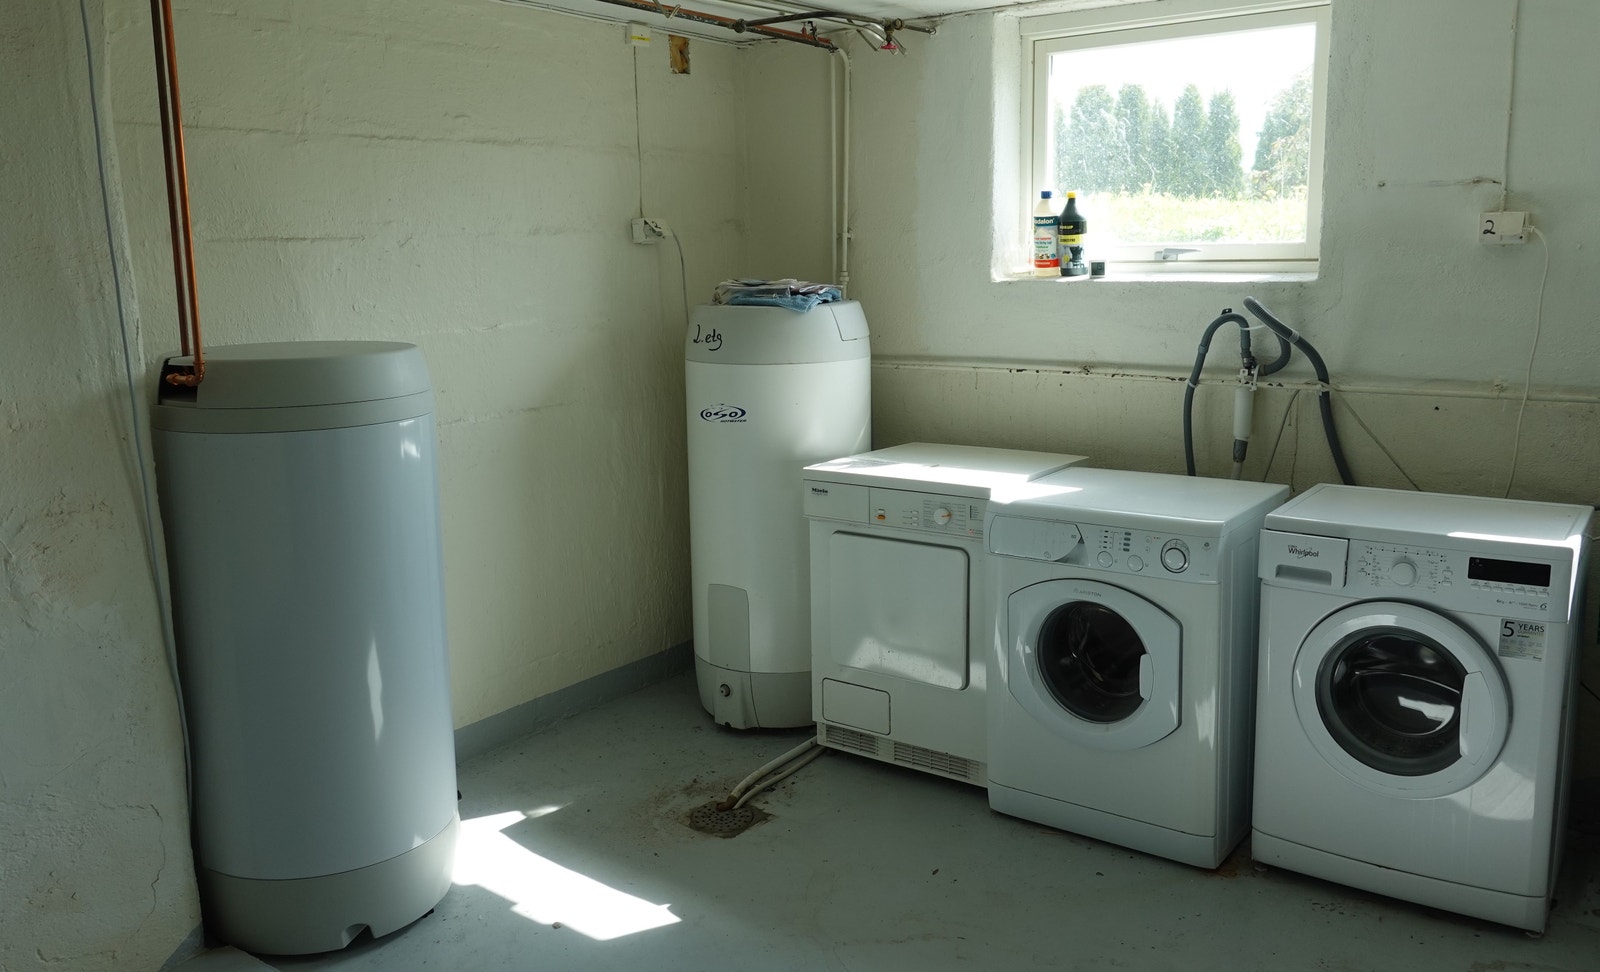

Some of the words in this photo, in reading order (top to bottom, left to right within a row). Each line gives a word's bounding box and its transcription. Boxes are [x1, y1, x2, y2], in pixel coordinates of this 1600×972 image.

[1483, 219, 1496, 234] 2
[1288, 546, 1319, 558] Whirlpool
[1502, 620, 1515, 637] 5
[1517, 623, 1545, 633] YEARS
